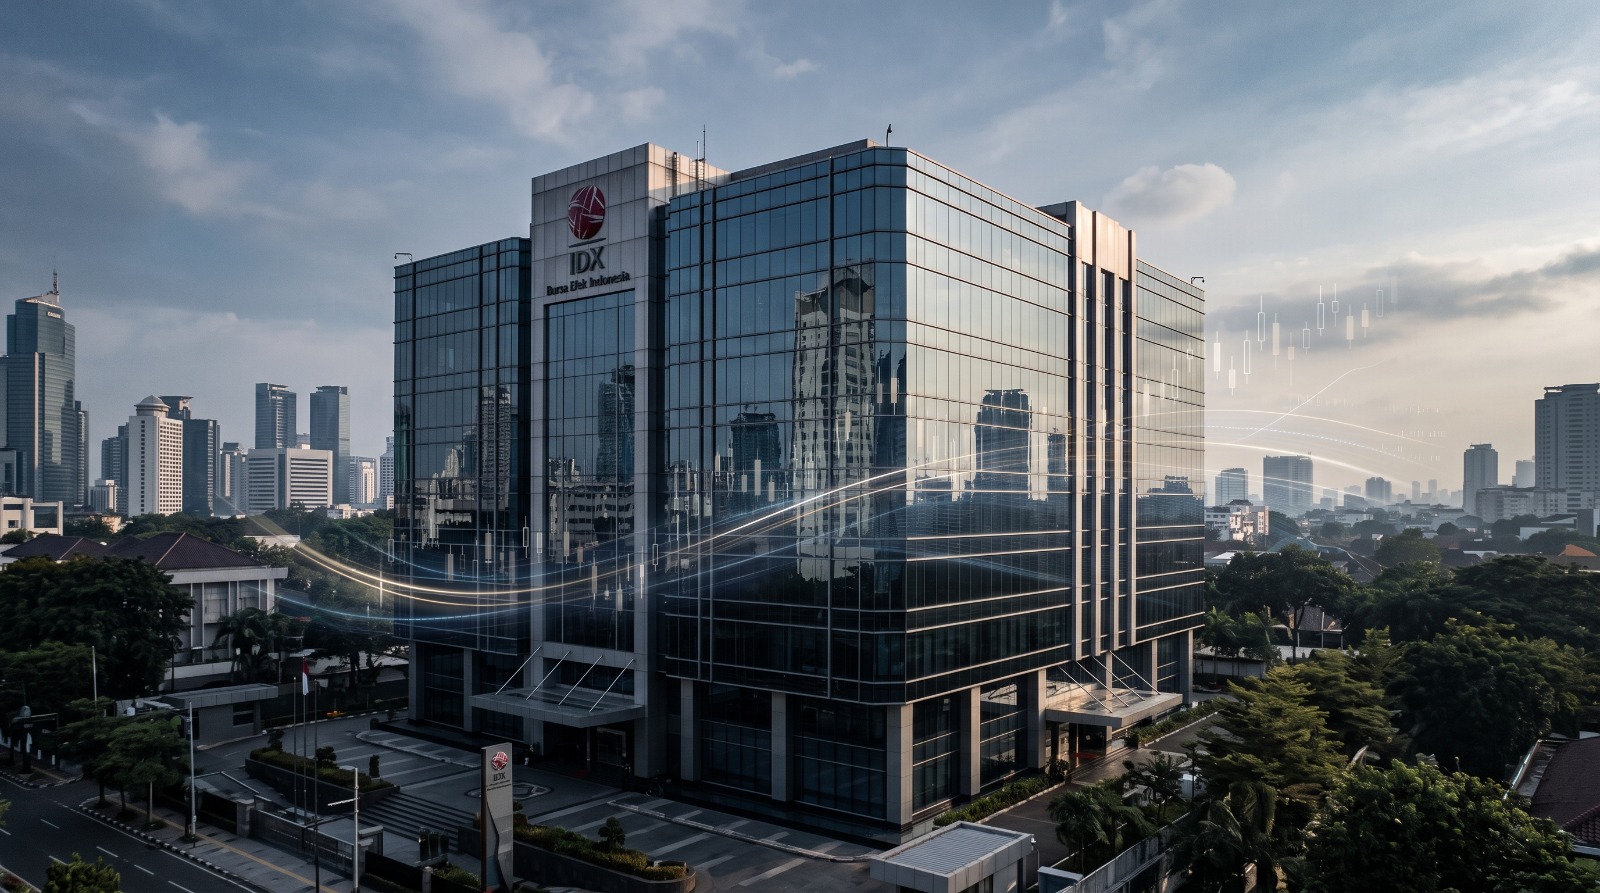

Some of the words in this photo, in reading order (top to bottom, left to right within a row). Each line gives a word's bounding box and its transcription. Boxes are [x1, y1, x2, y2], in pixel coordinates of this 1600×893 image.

[569, 246, 606, 275] IDX
[546, 285, 569, 296] Bursa
[589, 271, 631, 287] Indonesia
